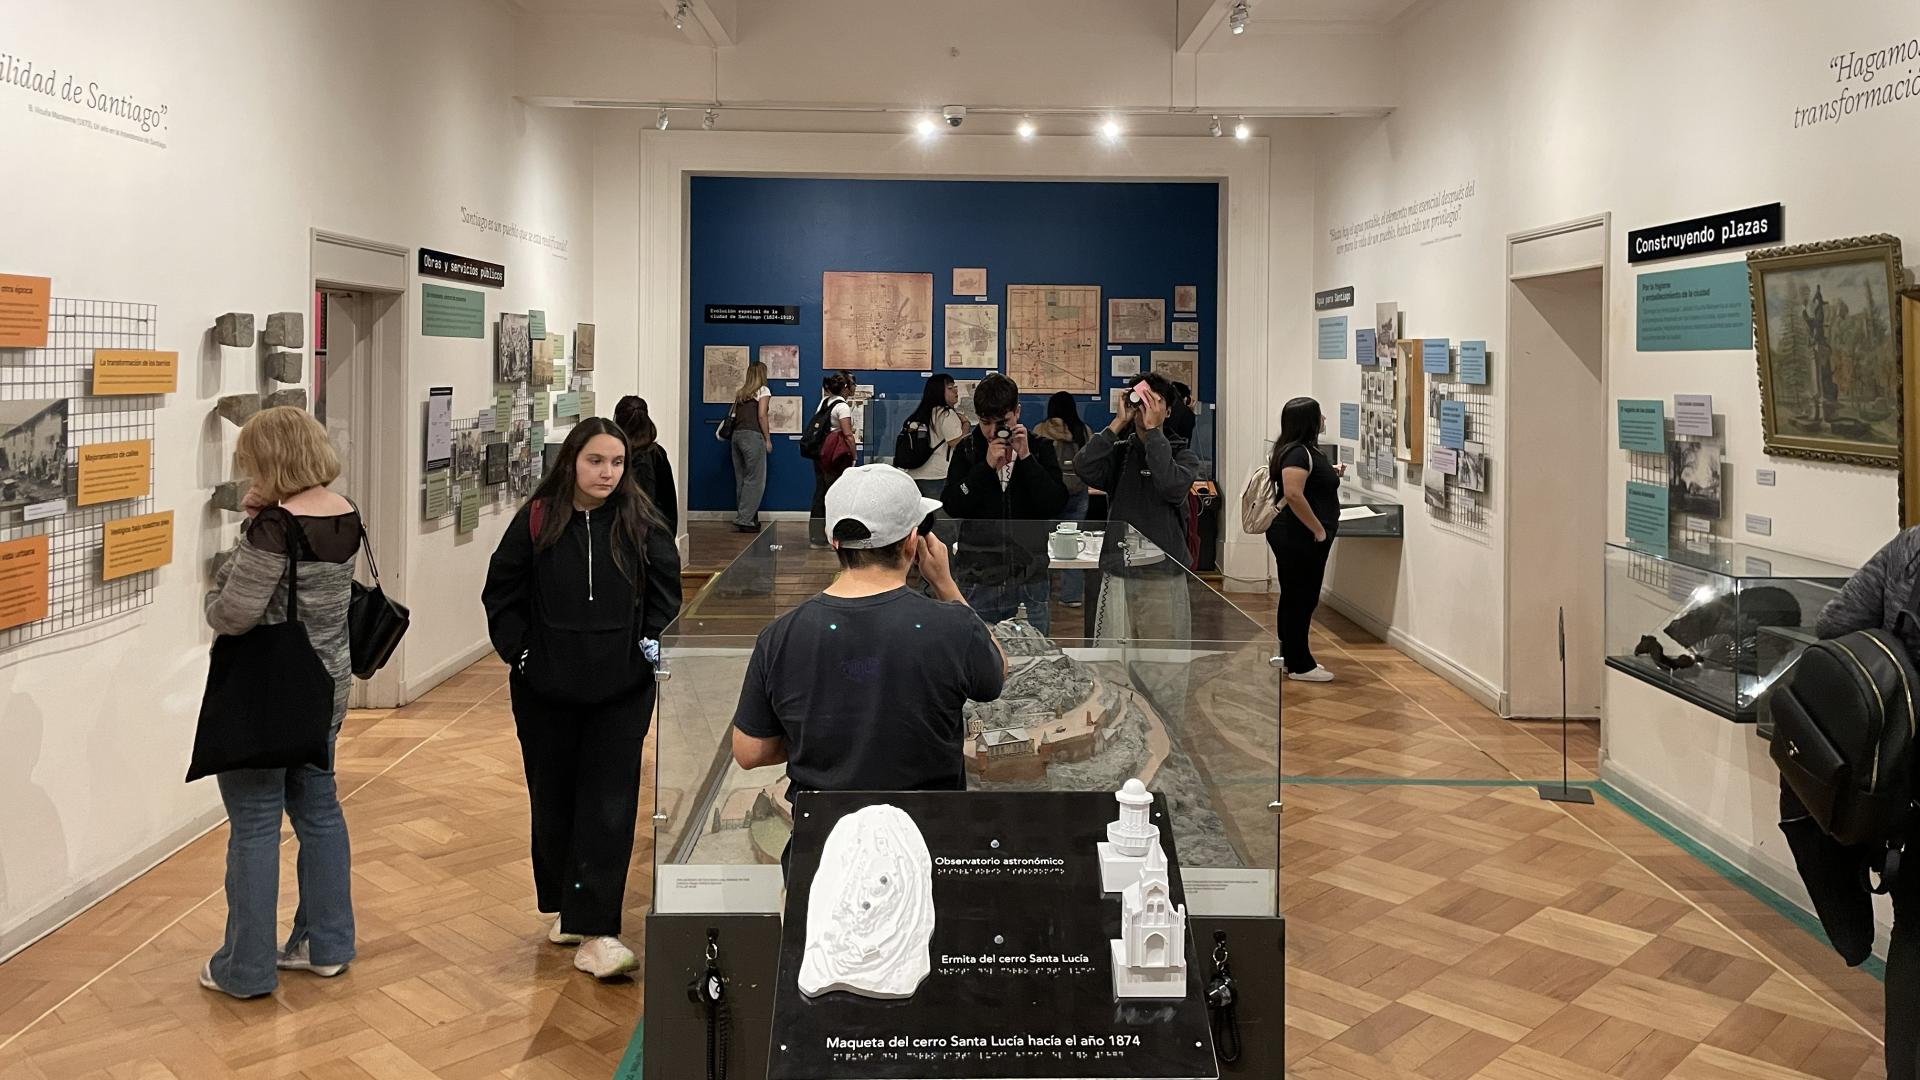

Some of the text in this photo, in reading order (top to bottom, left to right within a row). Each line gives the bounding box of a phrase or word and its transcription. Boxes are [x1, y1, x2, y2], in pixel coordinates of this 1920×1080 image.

[1829, 39, 1920, 83] “Hagamo
[61, 75, 83, 104] de
[1636, 218, 1769, 255] Construyendo plazas
[423, 254, 503, 281] Obras y servicios públicos
[935, 856, 1065, 866] Observatorio astronómico
[941, 953, 1090, 964] Ermita del cerro Santa Lucía
[826, 1034, 1141, 1051] Maqueta del cerro Santa Lucía hacía el año 1874
